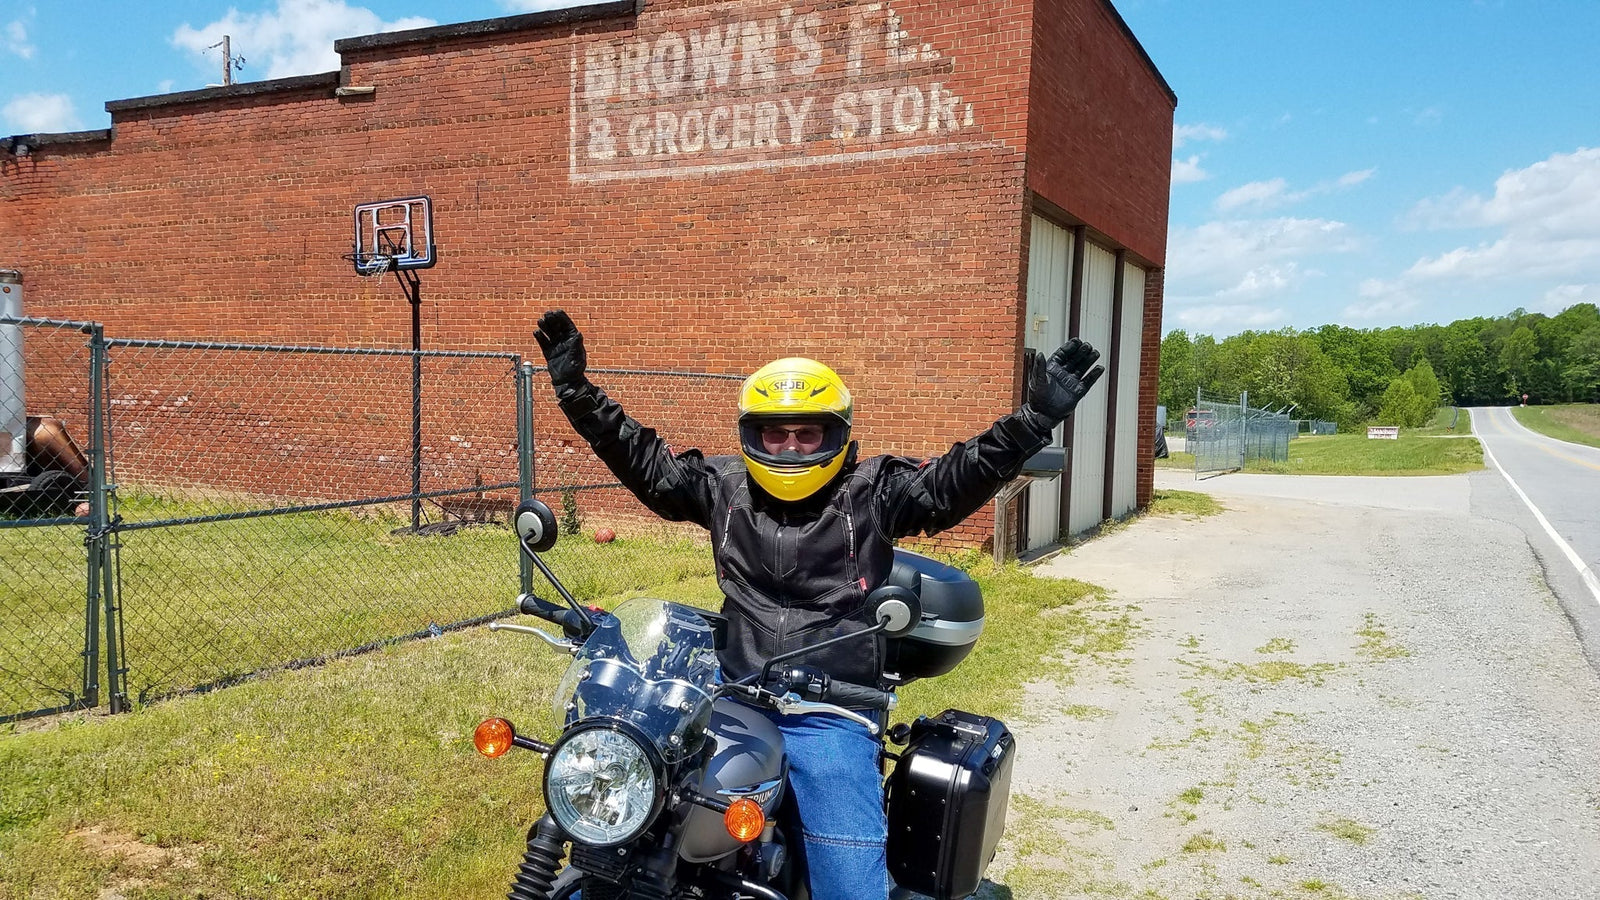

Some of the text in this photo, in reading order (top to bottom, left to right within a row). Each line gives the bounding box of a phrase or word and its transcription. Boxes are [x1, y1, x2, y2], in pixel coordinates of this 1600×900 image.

[585, 8, 822, 99] BROWN'S
[588, 117, 617, 159] &
[628, 97, 814, 156] GROCERY
[774, 381, 805, 390] SHOEI
